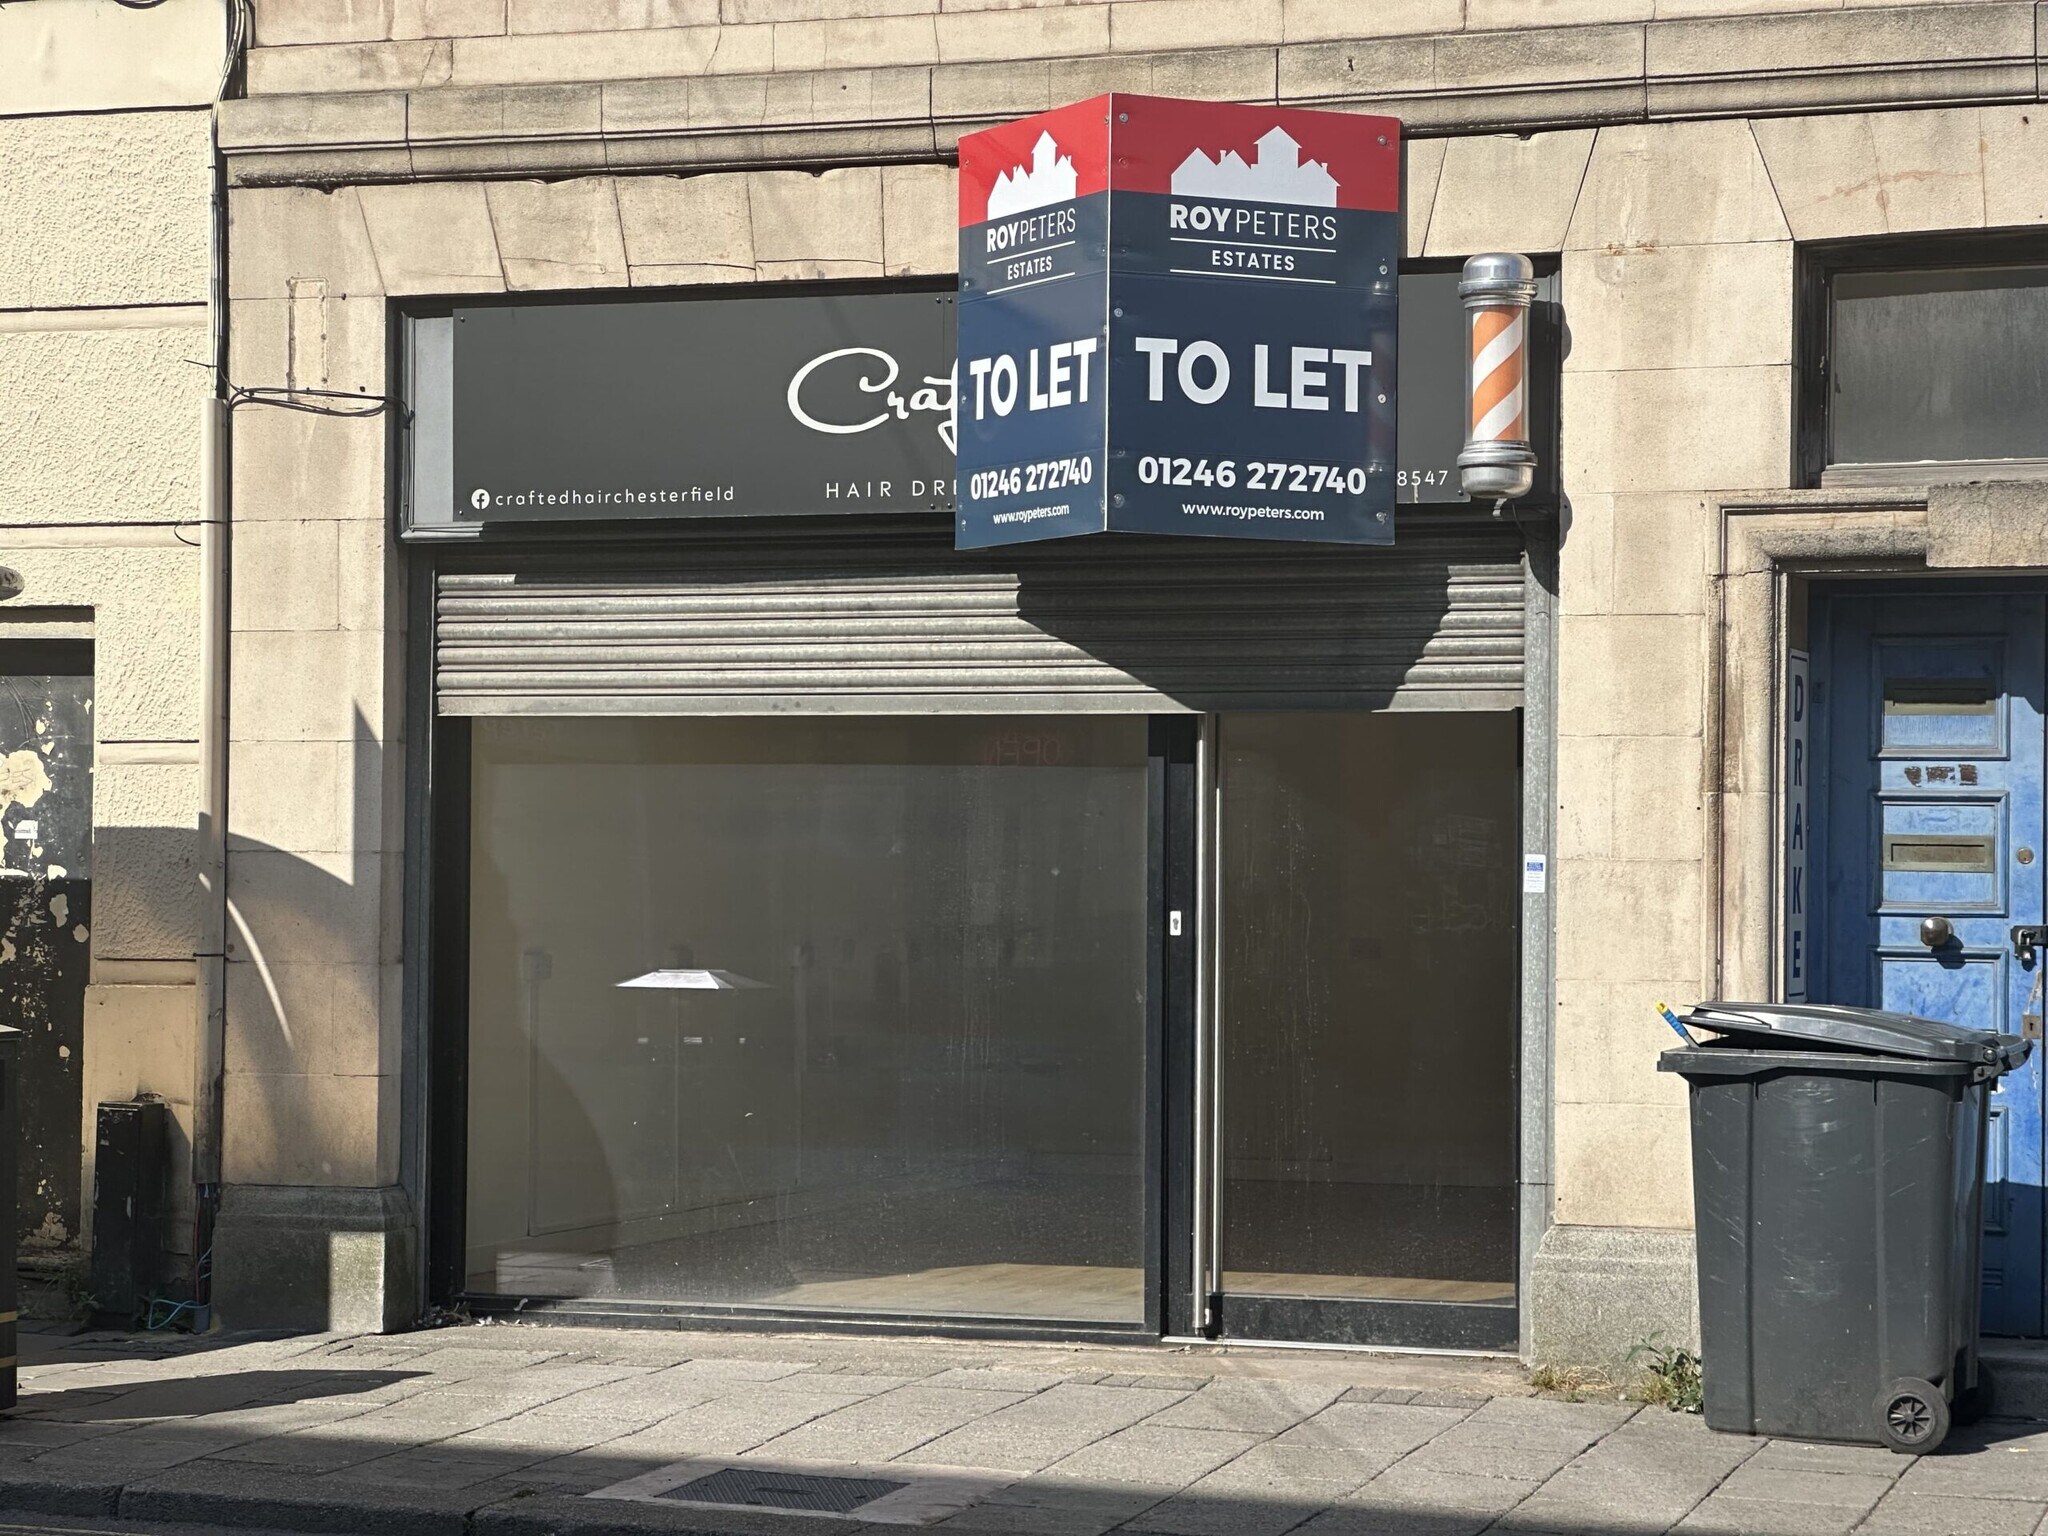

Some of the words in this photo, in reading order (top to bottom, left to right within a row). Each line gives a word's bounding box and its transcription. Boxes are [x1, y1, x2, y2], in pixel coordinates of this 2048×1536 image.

[1006, 255, 1054, 281] ESTATES
[1211, 249, 1296, 272] ESTATES
[969, 357, 1019, 421] TO
[1028, 337, 1098, 412] LET
[1134, 336, 1231, 405] TO
[1253, 344, 1373, 413] LET
[970, 466, 1022, 501] 01246
[1025, 455, 1093, 492] 272740
[1137, 456, 1237, 487] 01246
[1246, 461, 1368, 496] 272740
[1396, 469, 1449, 487] 8547
[495, 486, 735, 507] craftedhairchesterfield
[825, 481, 892, 499] HAIR
[992, 503, 1070, 524] www.roypeters.com
[1181, 502, 1325, 522] www.roypeters.com
[1791, 674, 1804, 979] DRAKE
